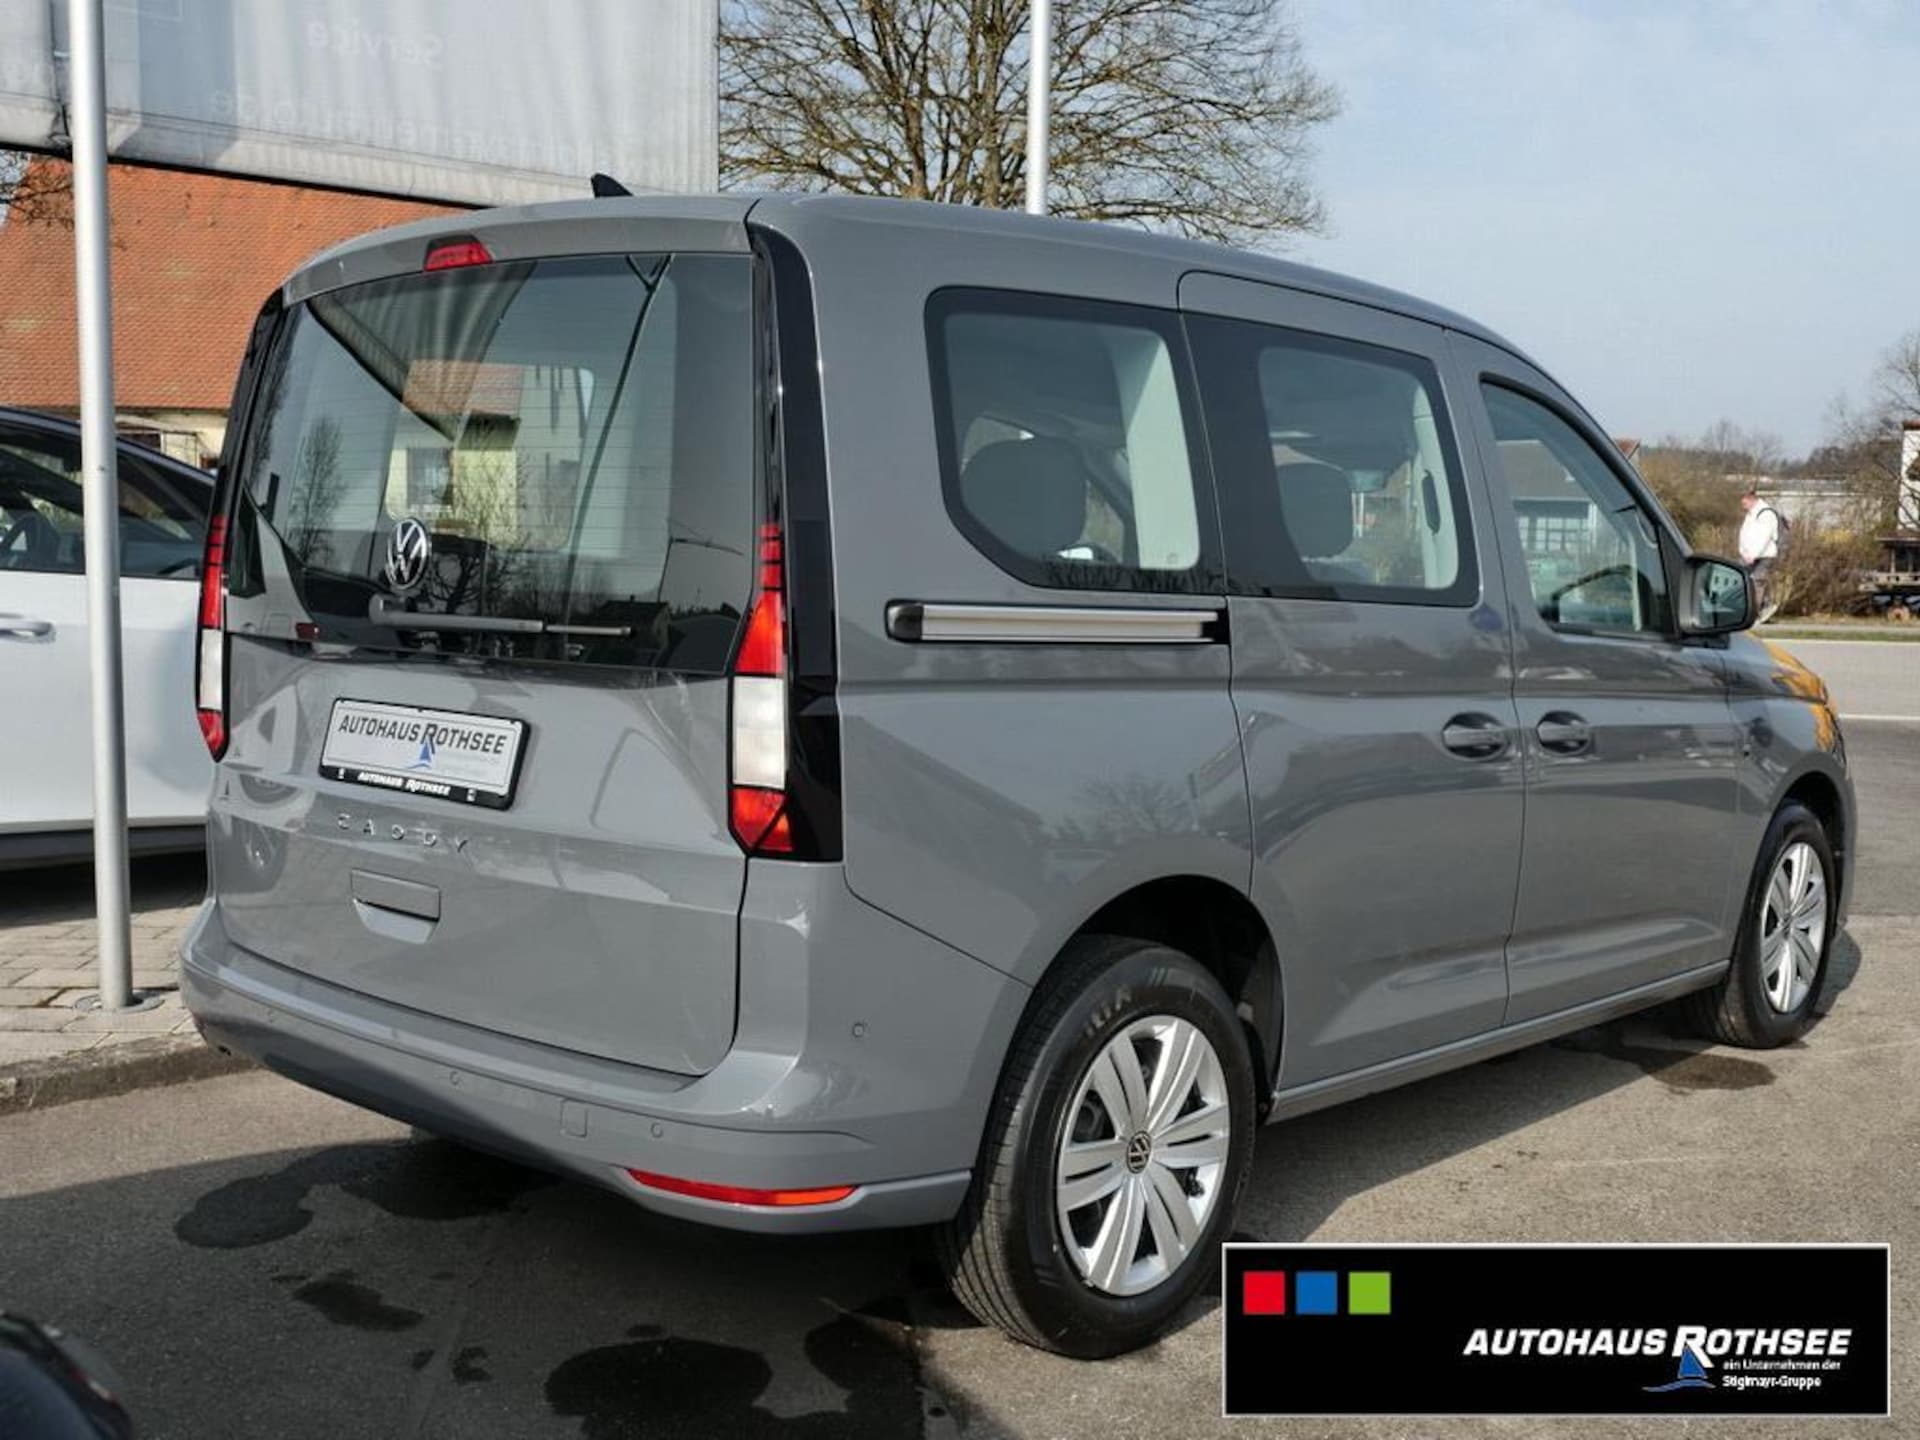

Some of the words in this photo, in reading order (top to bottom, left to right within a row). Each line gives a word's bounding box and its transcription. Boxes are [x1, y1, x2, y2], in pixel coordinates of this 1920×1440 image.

[338, 714, 421, 743] AUTOHAUS
[420, 722, 508, 755] ROTHSEE
[337, 812, 469, 853] CADDY
